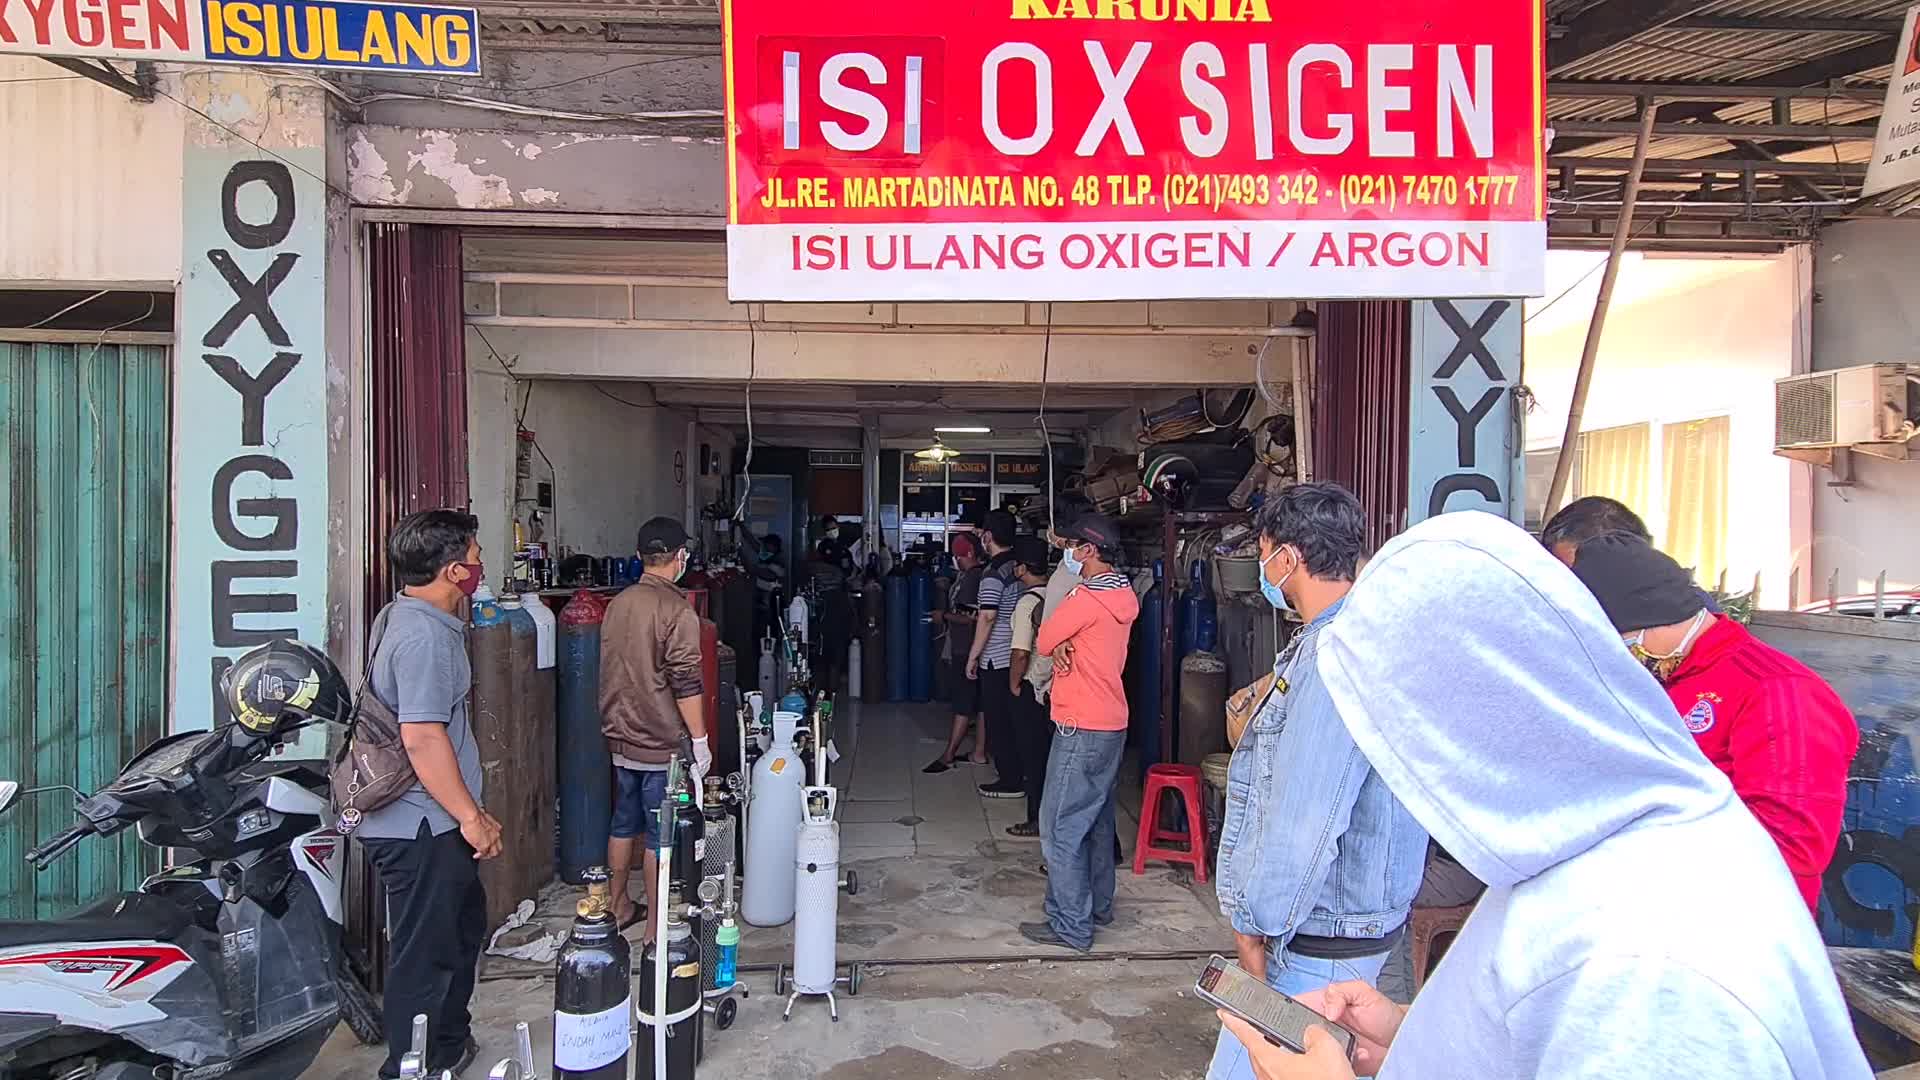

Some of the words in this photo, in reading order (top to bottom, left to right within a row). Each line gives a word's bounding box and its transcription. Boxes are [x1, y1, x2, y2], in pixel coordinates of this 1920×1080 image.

[1010, 0, 1272, 22] KARUNIA
[783, 51, 922, 154] ISI
[843, 177, 1018, 208] MARTADINATA
[1023, 177, 1064, 206] NO.
[1071, 176, 1100, 206] 48
[1106, 176, 1156, 206] TLP.
[1278, 175, 1318, 204] 342
[1340, 174, 1396, 213] (021)
[1404, 175, 1457, 204] 7470
[1466, 175, 1519, 205] 1777
[792, 235, 848, 270] ISI
[866, 234, 1044, 270] ULANG
[1060, 232, 1251, 270] OXIGEN
[1309, 231, 1490, 268] ARGON
